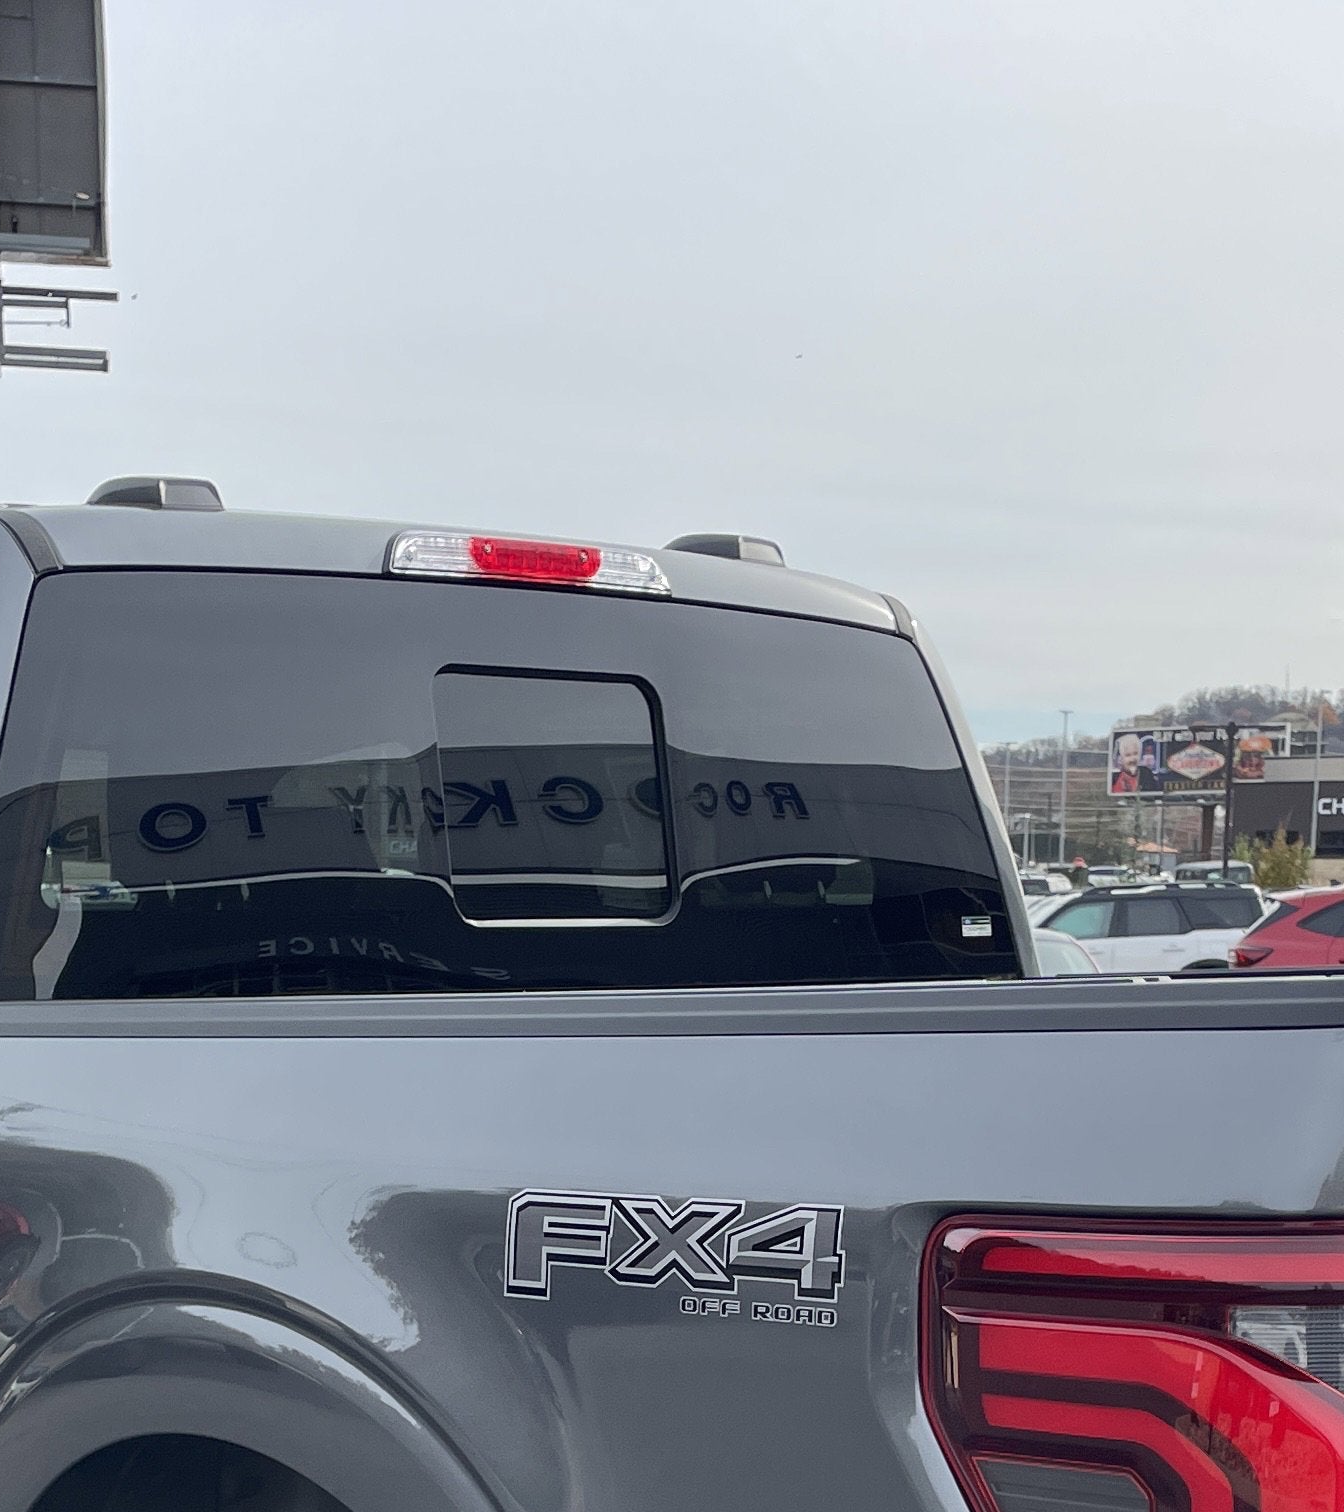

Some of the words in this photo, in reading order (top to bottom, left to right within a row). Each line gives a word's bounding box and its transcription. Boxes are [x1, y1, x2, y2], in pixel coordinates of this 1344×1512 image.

[503, 1188, 847, 1301] FX4
[680, 1296, 740, 1317] OFF
[751, 1301, 837, 1327] ROAD
